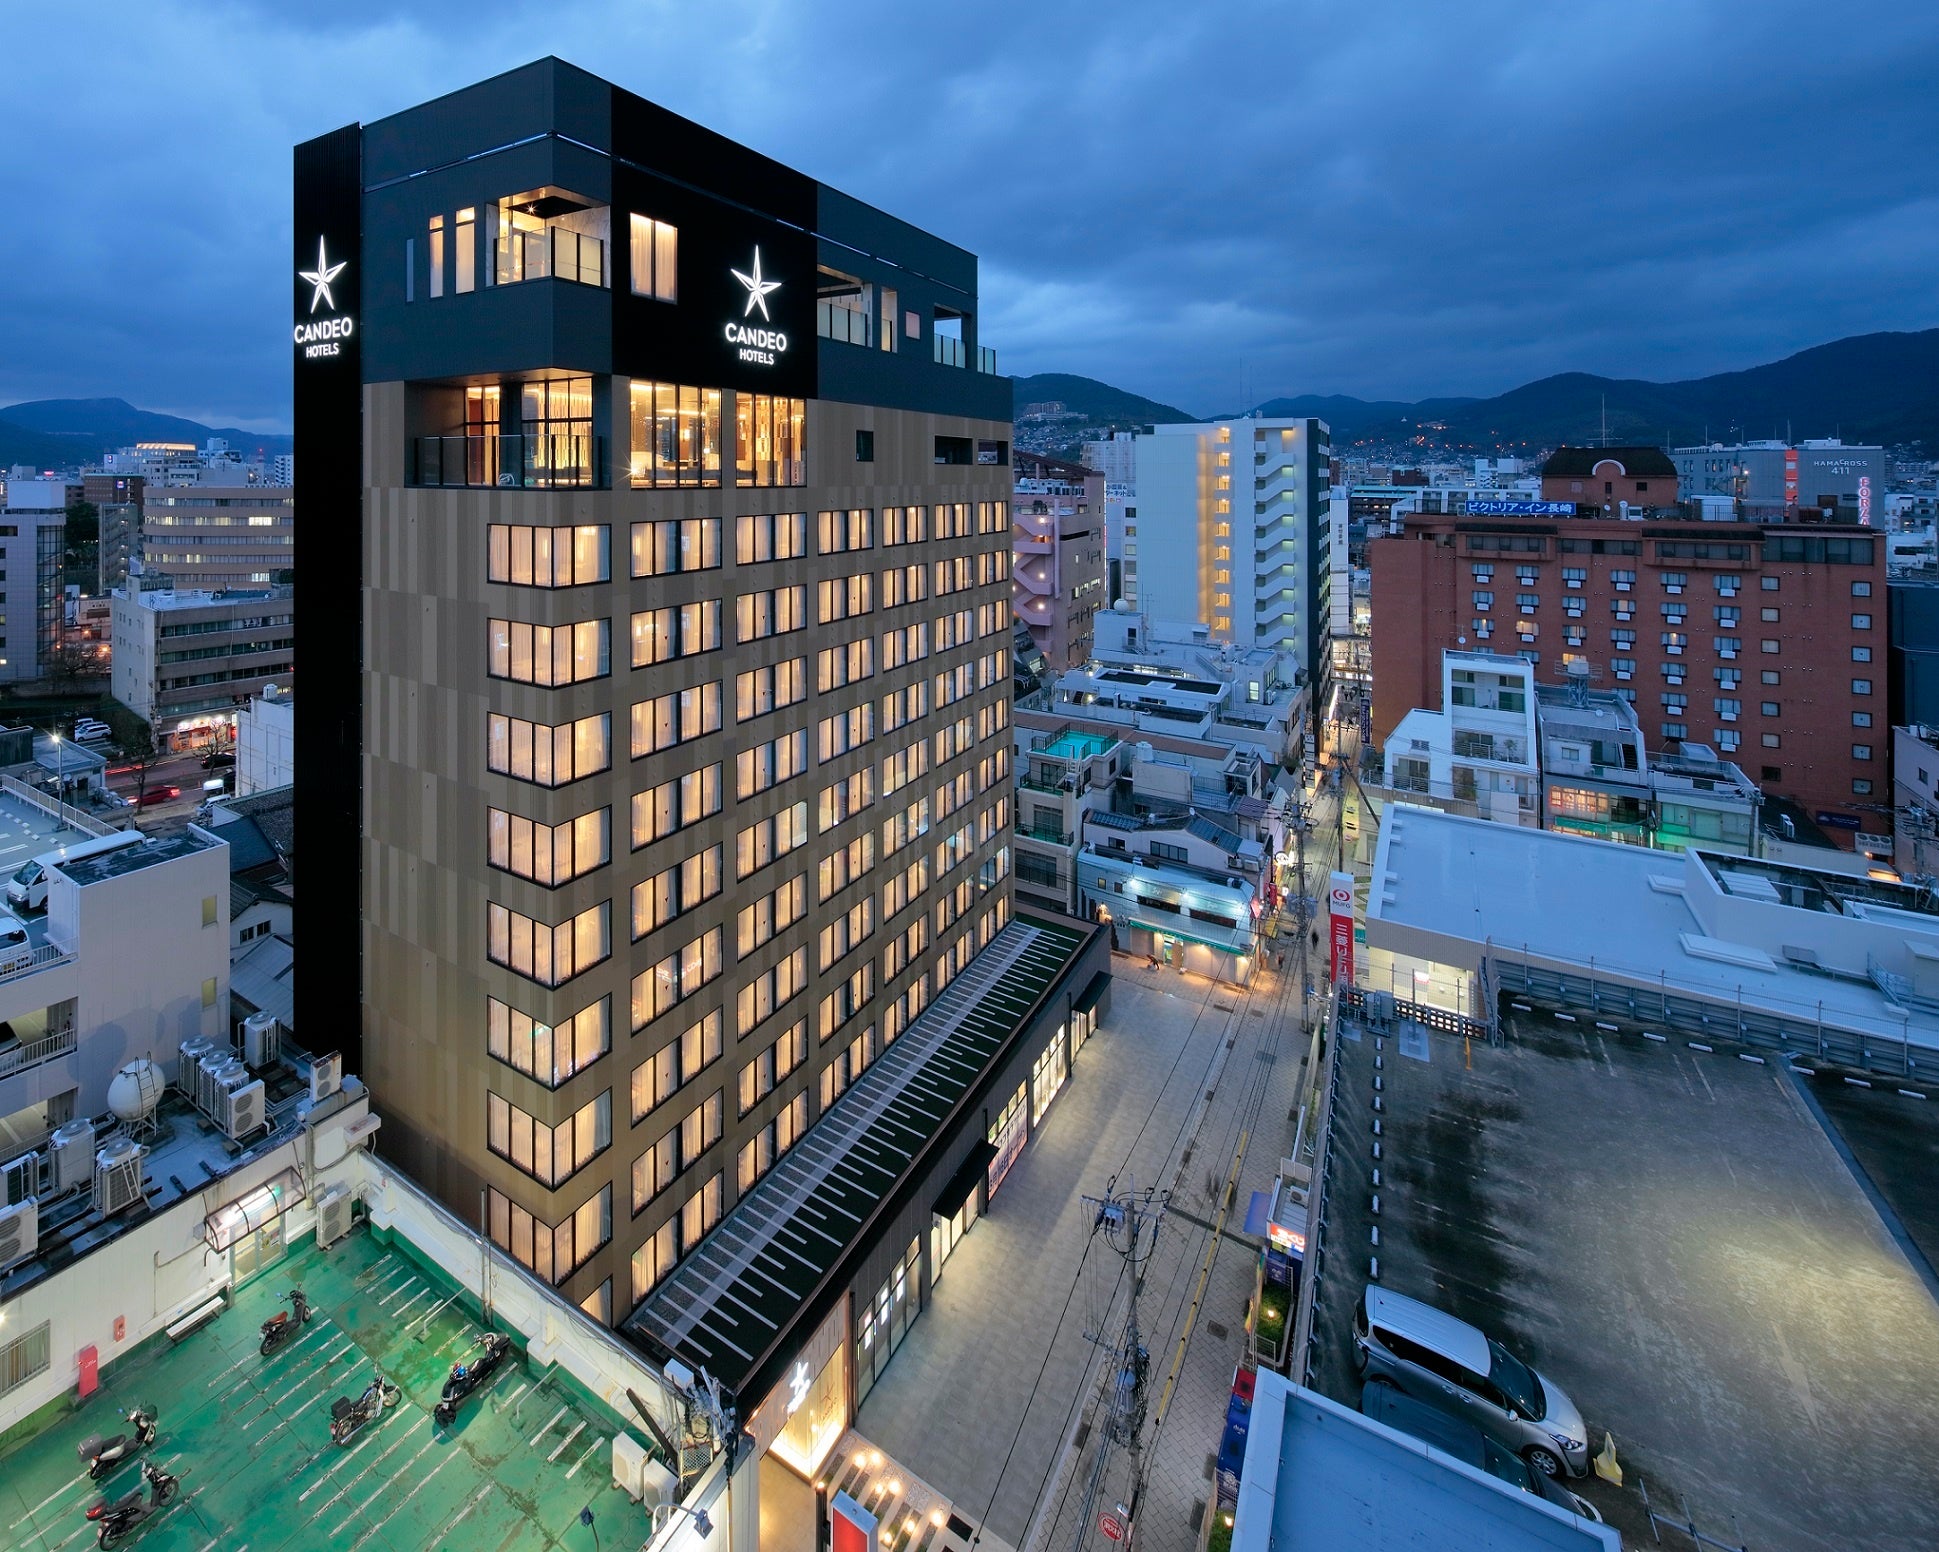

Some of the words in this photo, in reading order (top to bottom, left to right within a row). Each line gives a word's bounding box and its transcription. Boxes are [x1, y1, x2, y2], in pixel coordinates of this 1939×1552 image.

[294, 317, 353, 343] CANDEO
[724, 322, 787, 352] CANDEO
[306, 342, 339, 358] HOTELS
[739, 348, 775, 365] HOTELS
[1813, 459, 1868, 467] HAMACROSS
[1831, 466, 1850, 475] 411
[1468, 502, 1573, 513] ビクトリア・イン長崎
[1859, 477, 1871, 526] FORZA
[1332, 900, 1351, 909] MUFG
